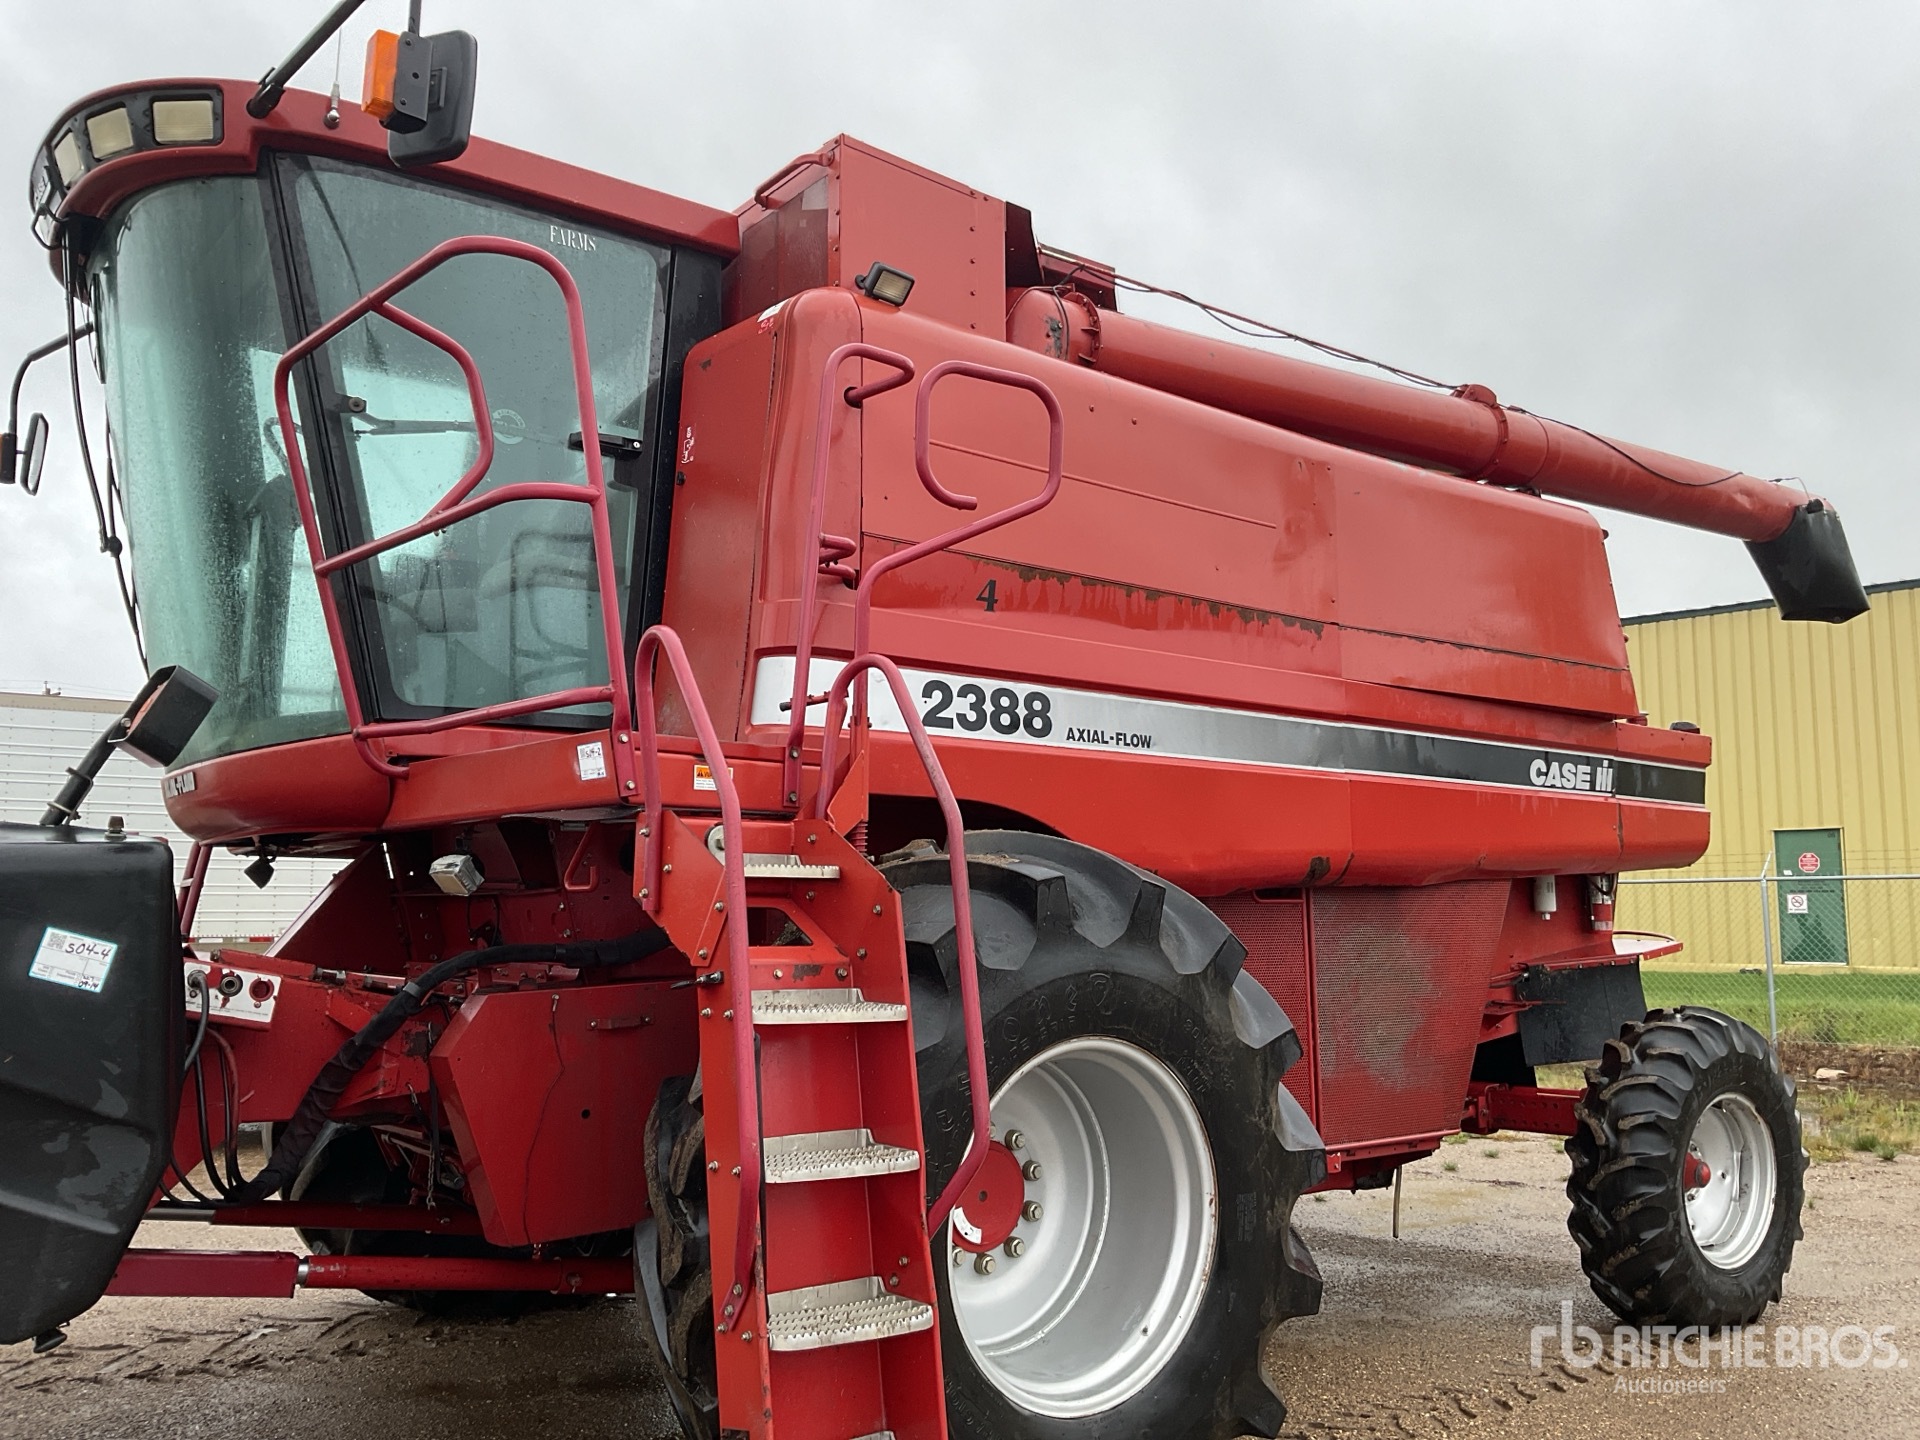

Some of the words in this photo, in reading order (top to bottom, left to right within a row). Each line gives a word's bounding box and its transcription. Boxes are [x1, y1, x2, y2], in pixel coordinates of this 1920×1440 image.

[550, 225, 597, 251] FARMS
[976, 579, 999, 612] 4
[921, 679, 1053, 738] 2388
[1066, 727, 1152, 749] AXIAL-FLOW
[1529, 758, 1591, 790] CASE
